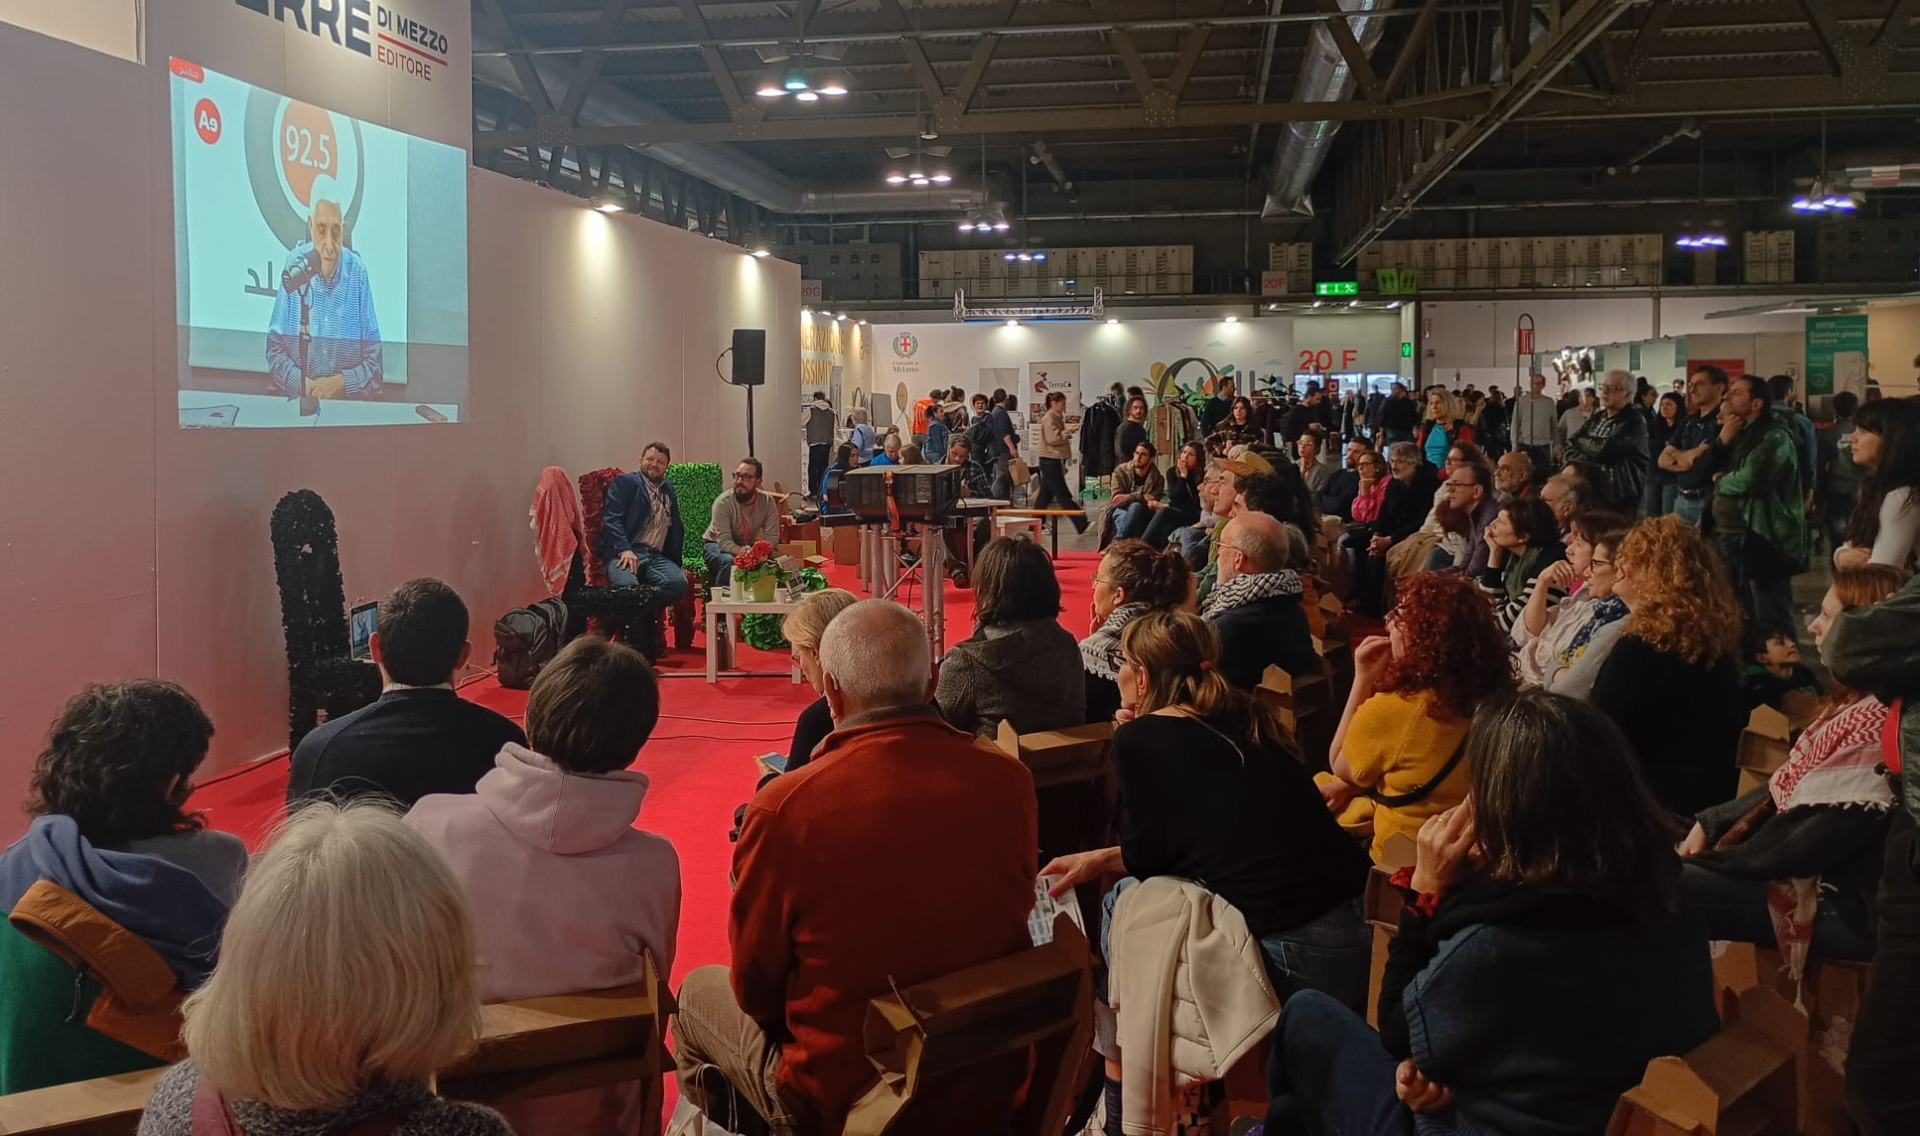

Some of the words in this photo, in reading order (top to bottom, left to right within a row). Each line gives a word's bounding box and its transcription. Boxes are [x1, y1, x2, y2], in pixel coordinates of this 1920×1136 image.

[235, 0, 371, 57] RRE
[377, 5, 392, 31] DI
[397, 15, 448, 55] MEZZO
[377, 45, 432, 81] EDITORE
[286, 125, 331, 170] 92.5
[1264, 277, 1286, 289] 20F
[1299, 349, 1333, 371] 20
[1342, 349, 1358, 371] F
